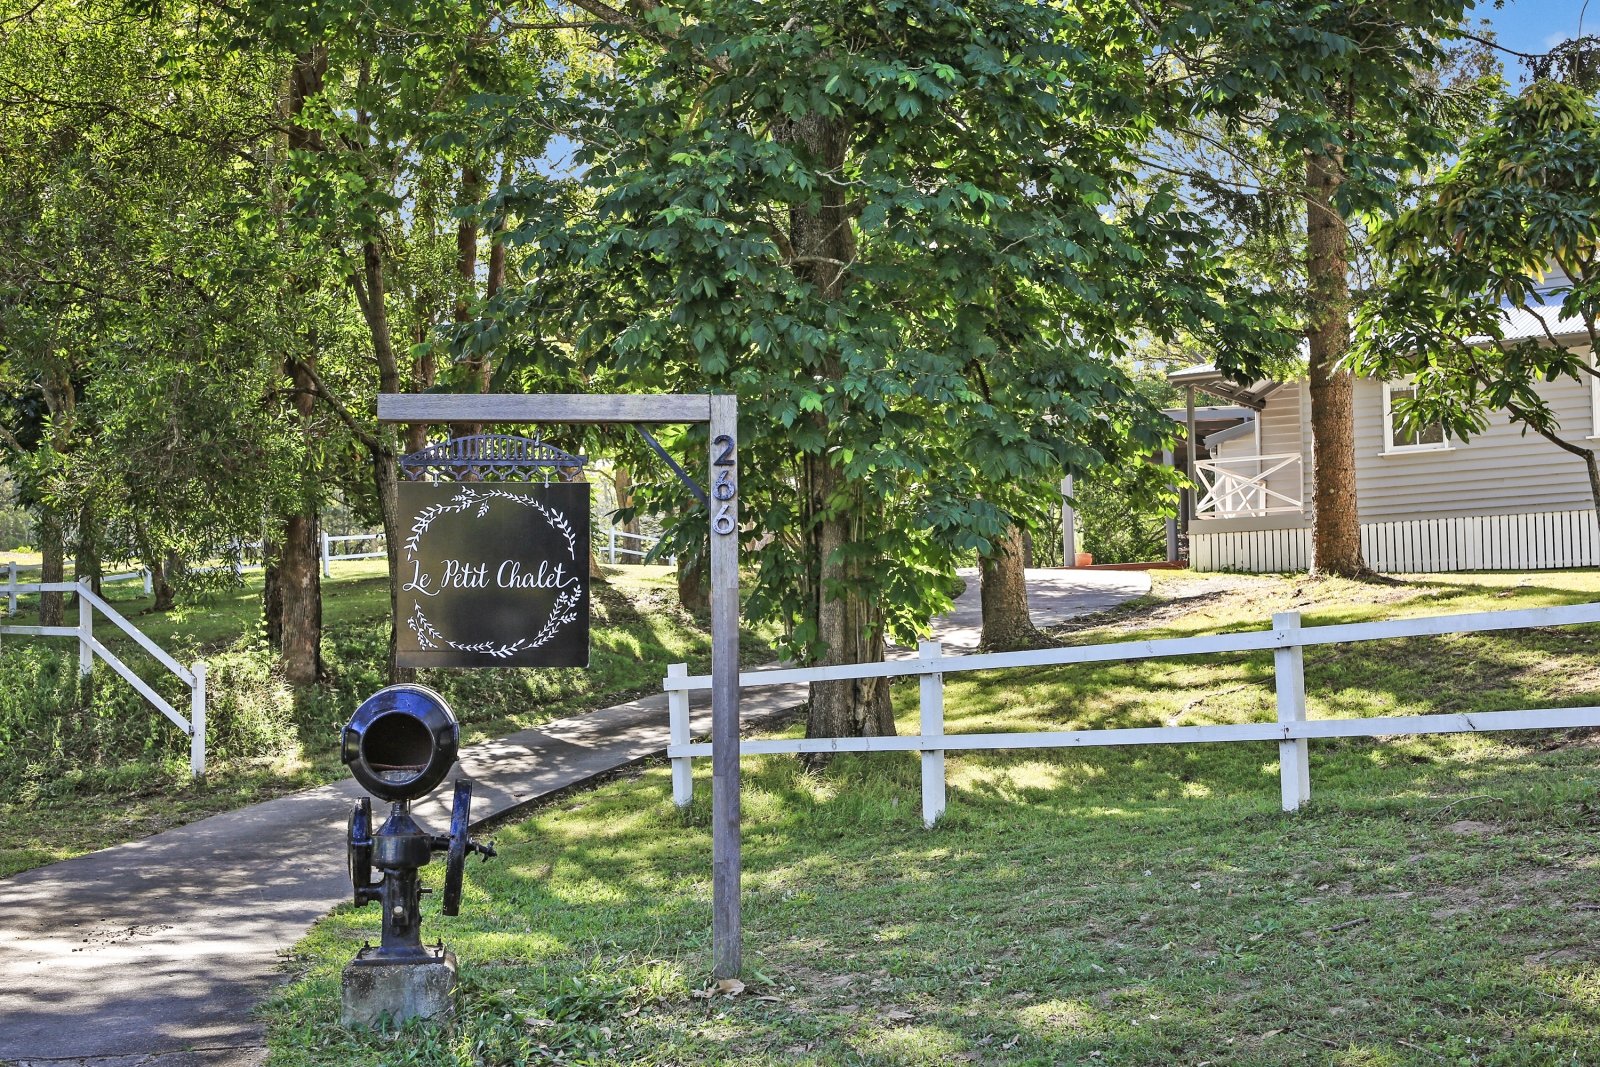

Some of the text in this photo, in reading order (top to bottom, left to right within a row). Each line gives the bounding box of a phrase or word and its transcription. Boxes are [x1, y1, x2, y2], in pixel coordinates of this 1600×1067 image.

[713, 434, 735, 535] 266
[402, 559, 579, 596] Le Petit Chalet
